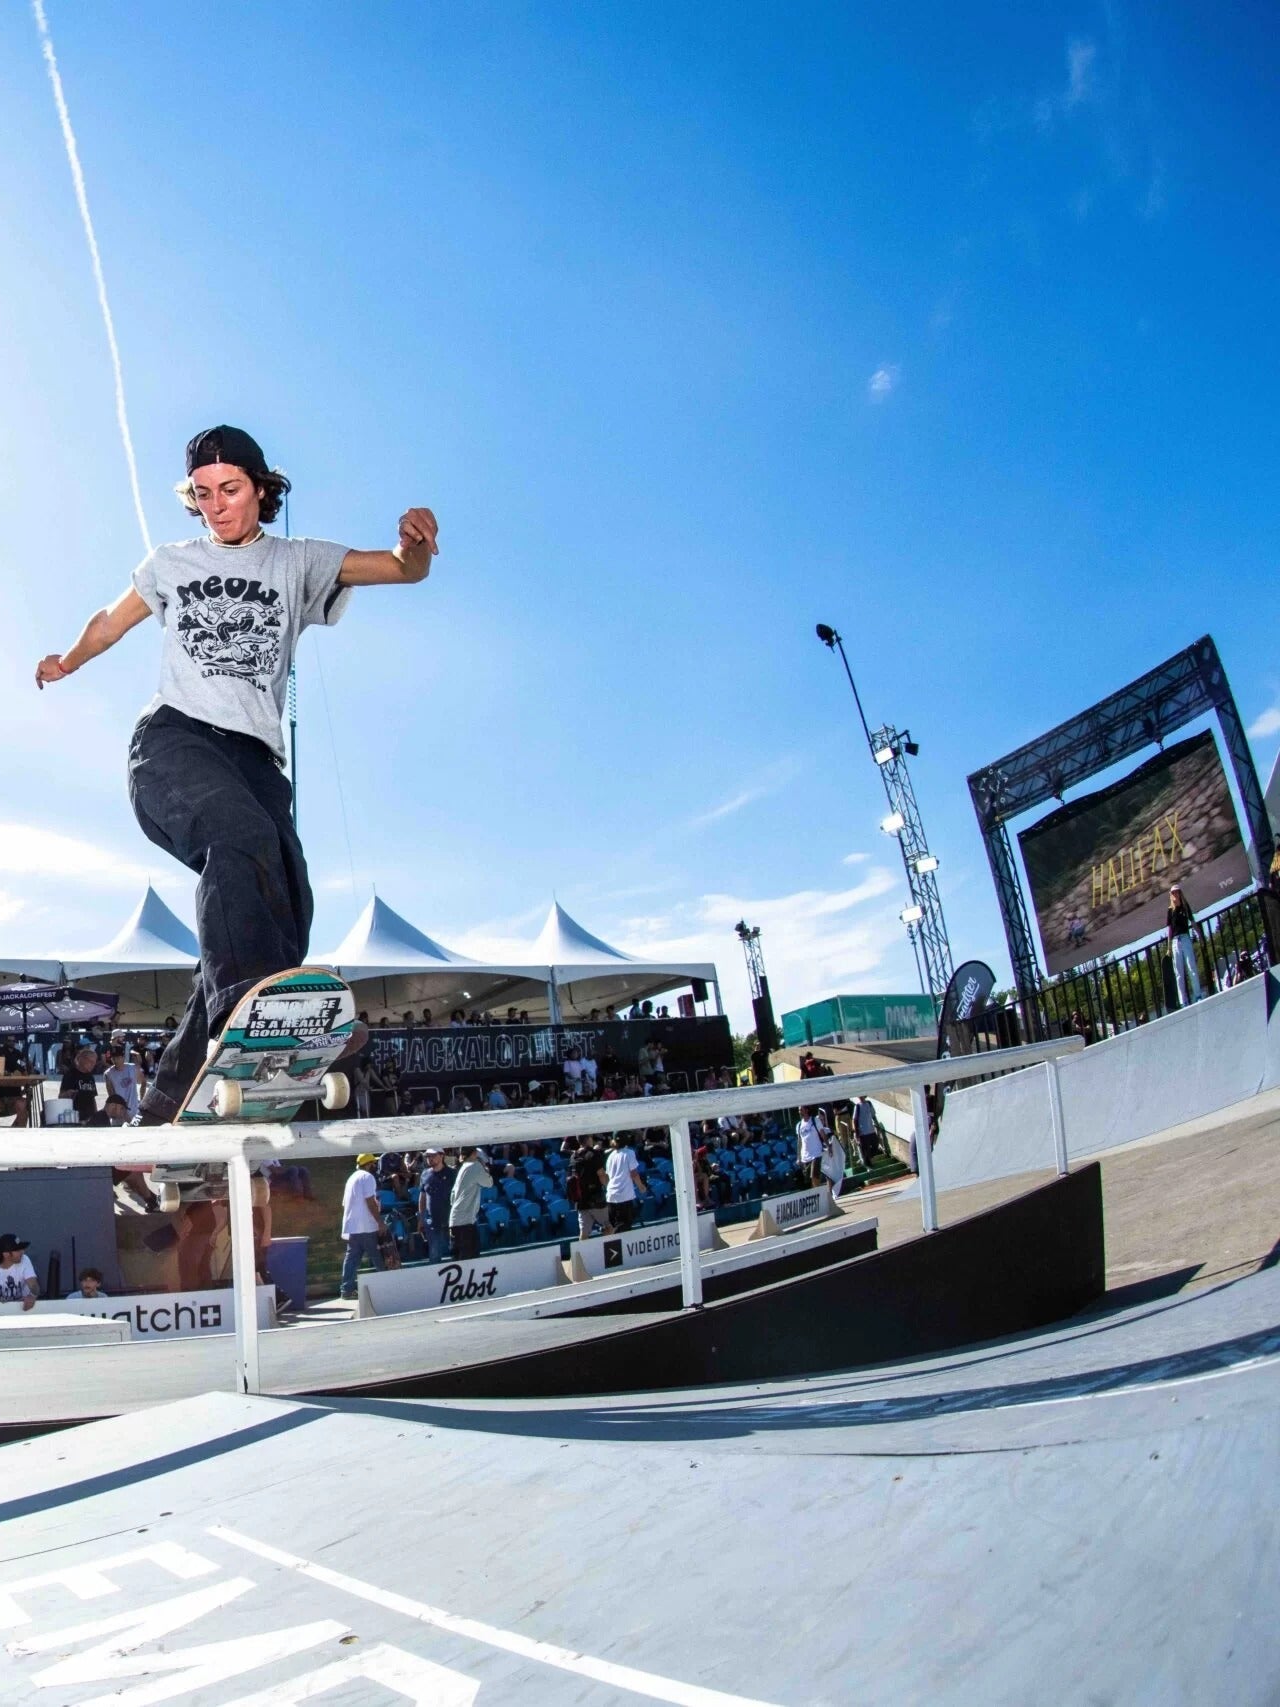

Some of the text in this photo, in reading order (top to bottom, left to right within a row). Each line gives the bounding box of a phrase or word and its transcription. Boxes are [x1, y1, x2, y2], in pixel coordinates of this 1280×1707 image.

[1092, 812, 1185, 908] HALIFAX
[249, 1027, 325, 1037] GOOD IDEA
[251, 1018, 330, 1029] IS A REALLY
[776, 1193, 821, 1224] #JACKALOPEFEST
[626, 1233, 681, 1257] VIDÉOTRO
[438, 1264, 499, 1303] Pabst
